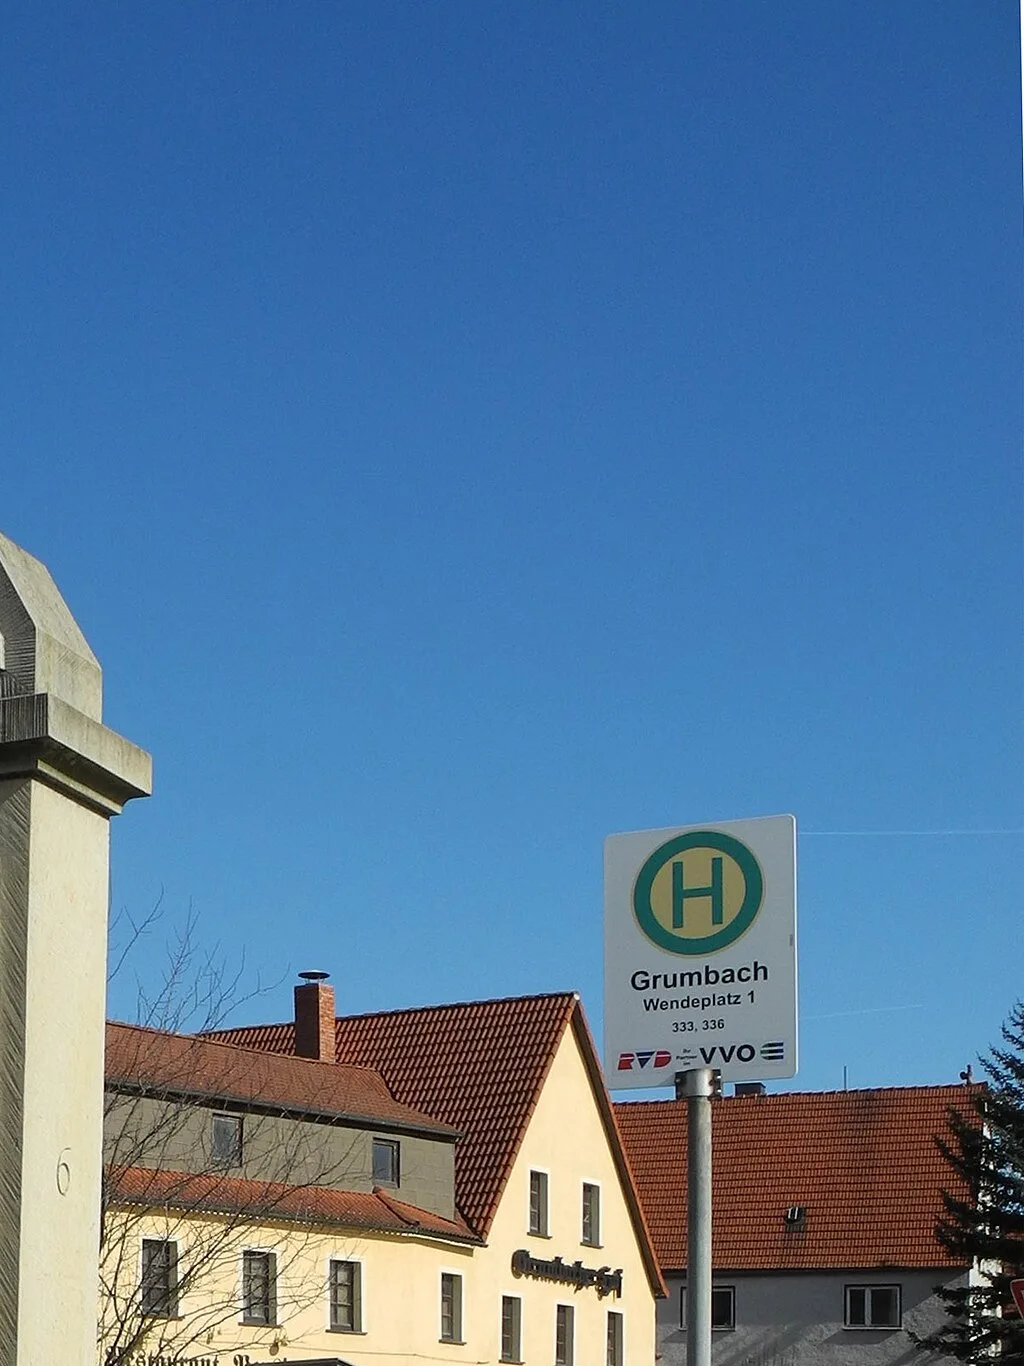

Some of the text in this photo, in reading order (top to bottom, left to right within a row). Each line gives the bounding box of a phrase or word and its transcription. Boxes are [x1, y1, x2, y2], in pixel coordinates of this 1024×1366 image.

[631, 961, 768, 991] Grumbach
[643, 990, 755, 1011] Wendeplatz 1
[672, 1019, 725, 1033] 333, 336
[618, 1050, 672, 1070] RVD
[699, 1044, 755, 1064] VVO
